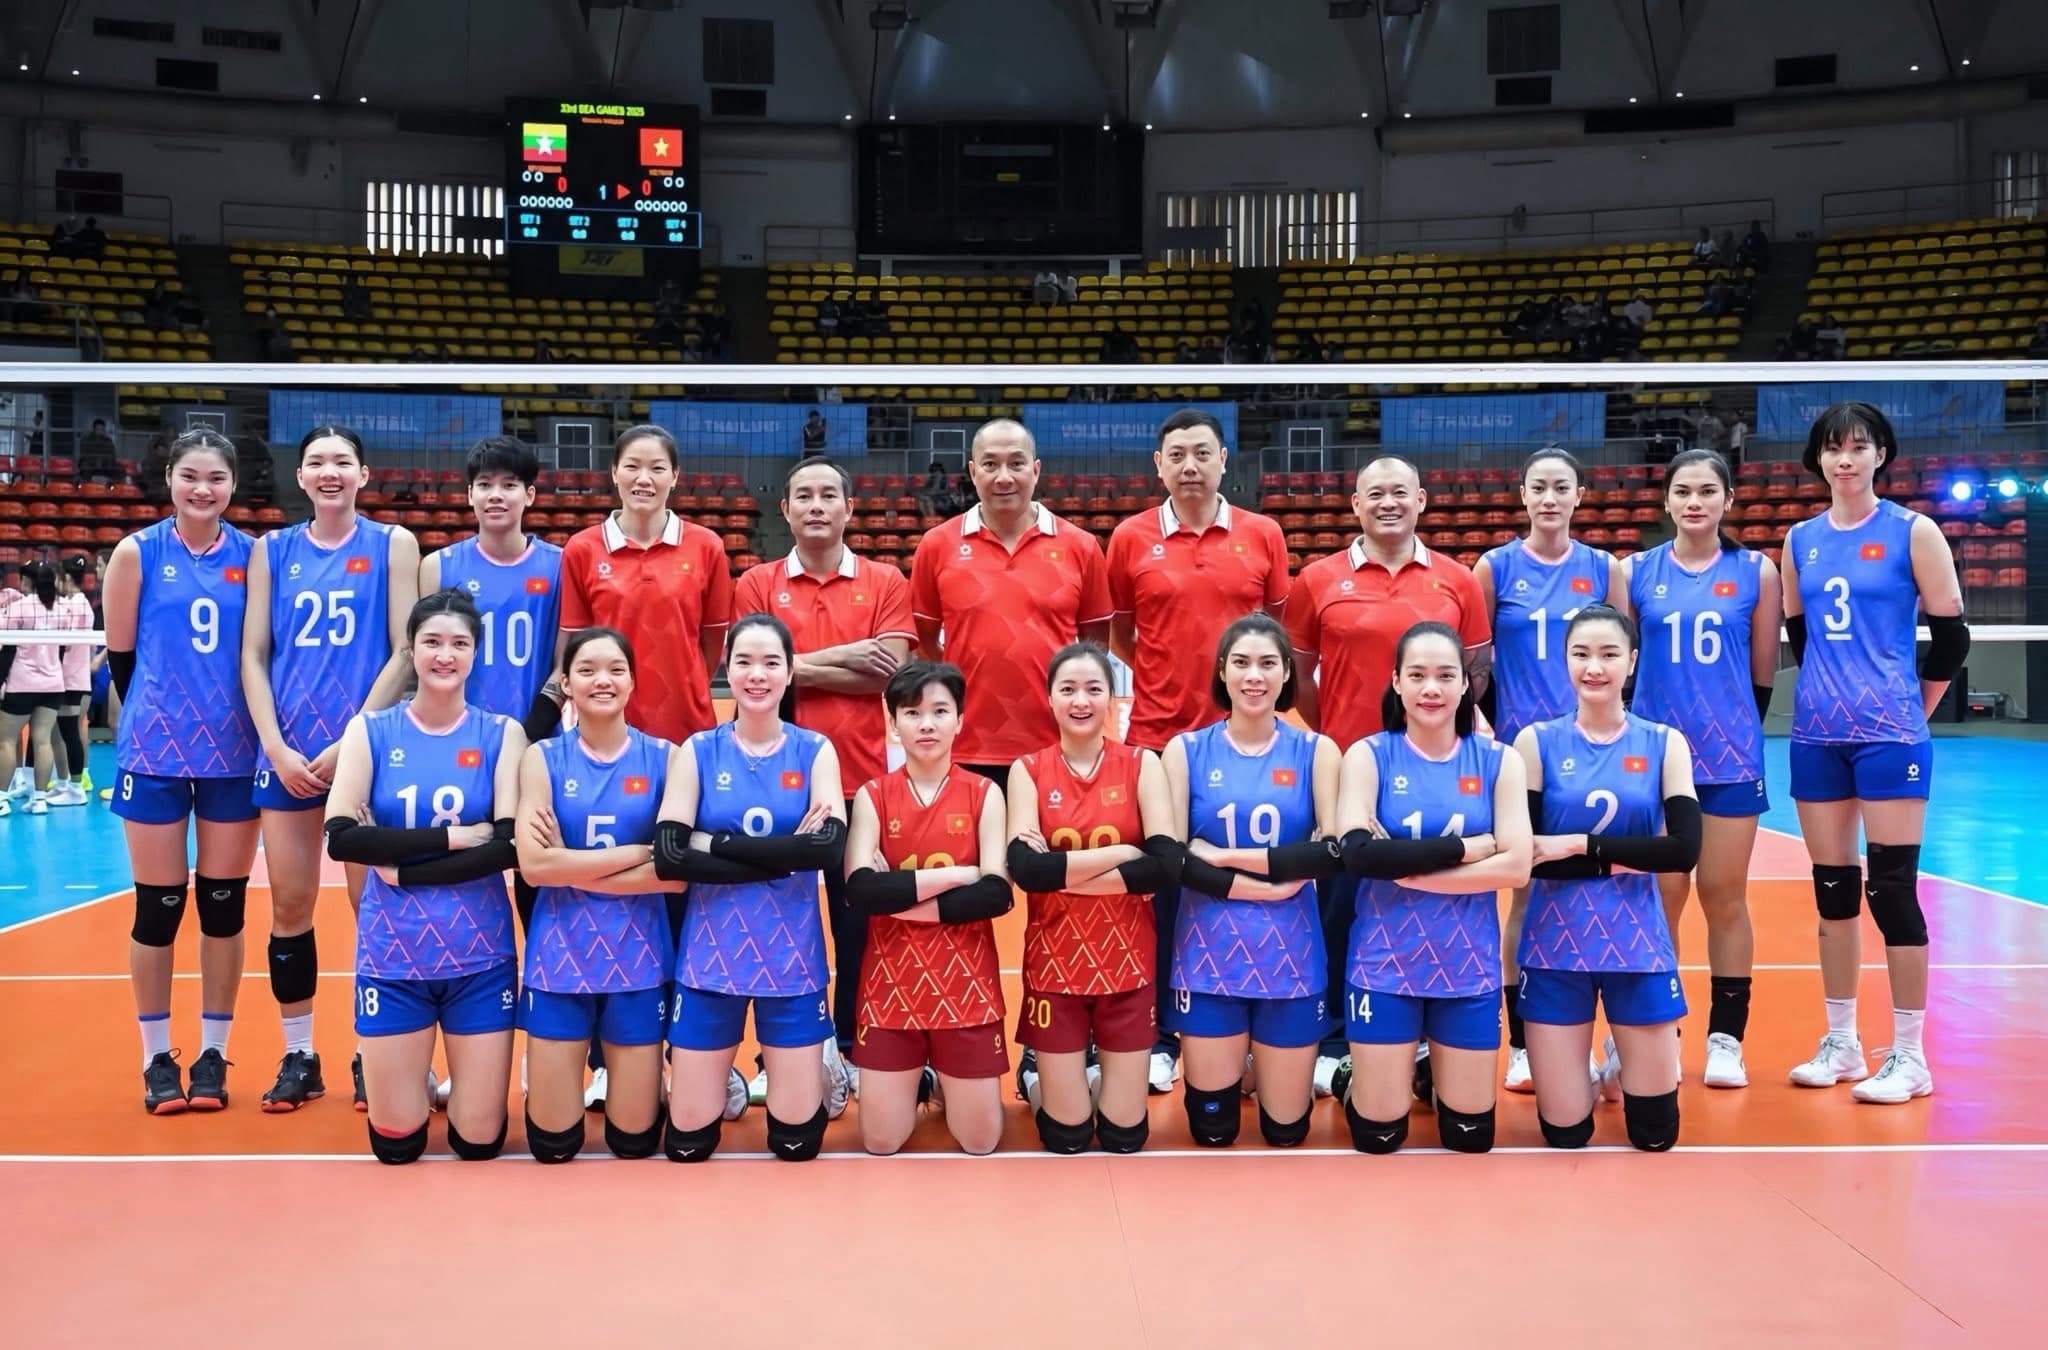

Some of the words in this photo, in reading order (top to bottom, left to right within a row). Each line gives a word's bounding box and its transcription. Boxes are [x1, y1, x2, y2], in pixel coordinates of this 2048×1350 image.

[558, 176, 567, 193] 0
[600, 184, 606, 200] 1
[642, 180, 651, 196] 0
[190, 598, 219, 653] 9
[295, 590, 356, 647] 25
[1824, 577, 1851, 632] 3
[481, 611, 533, 667] 10
[1663, 611, 1721, 664] 16
[122, 774, 133, 800] 9
[397, 785, 465, 828] 18
[586, 815, 616, 849] 5
[1217, 803, 1280, 849] 19
[1585, 789, 1619, 835] 2
[1027, 997, 1051, 1028] 20
[1349, 992, 1372, 1023] 14
